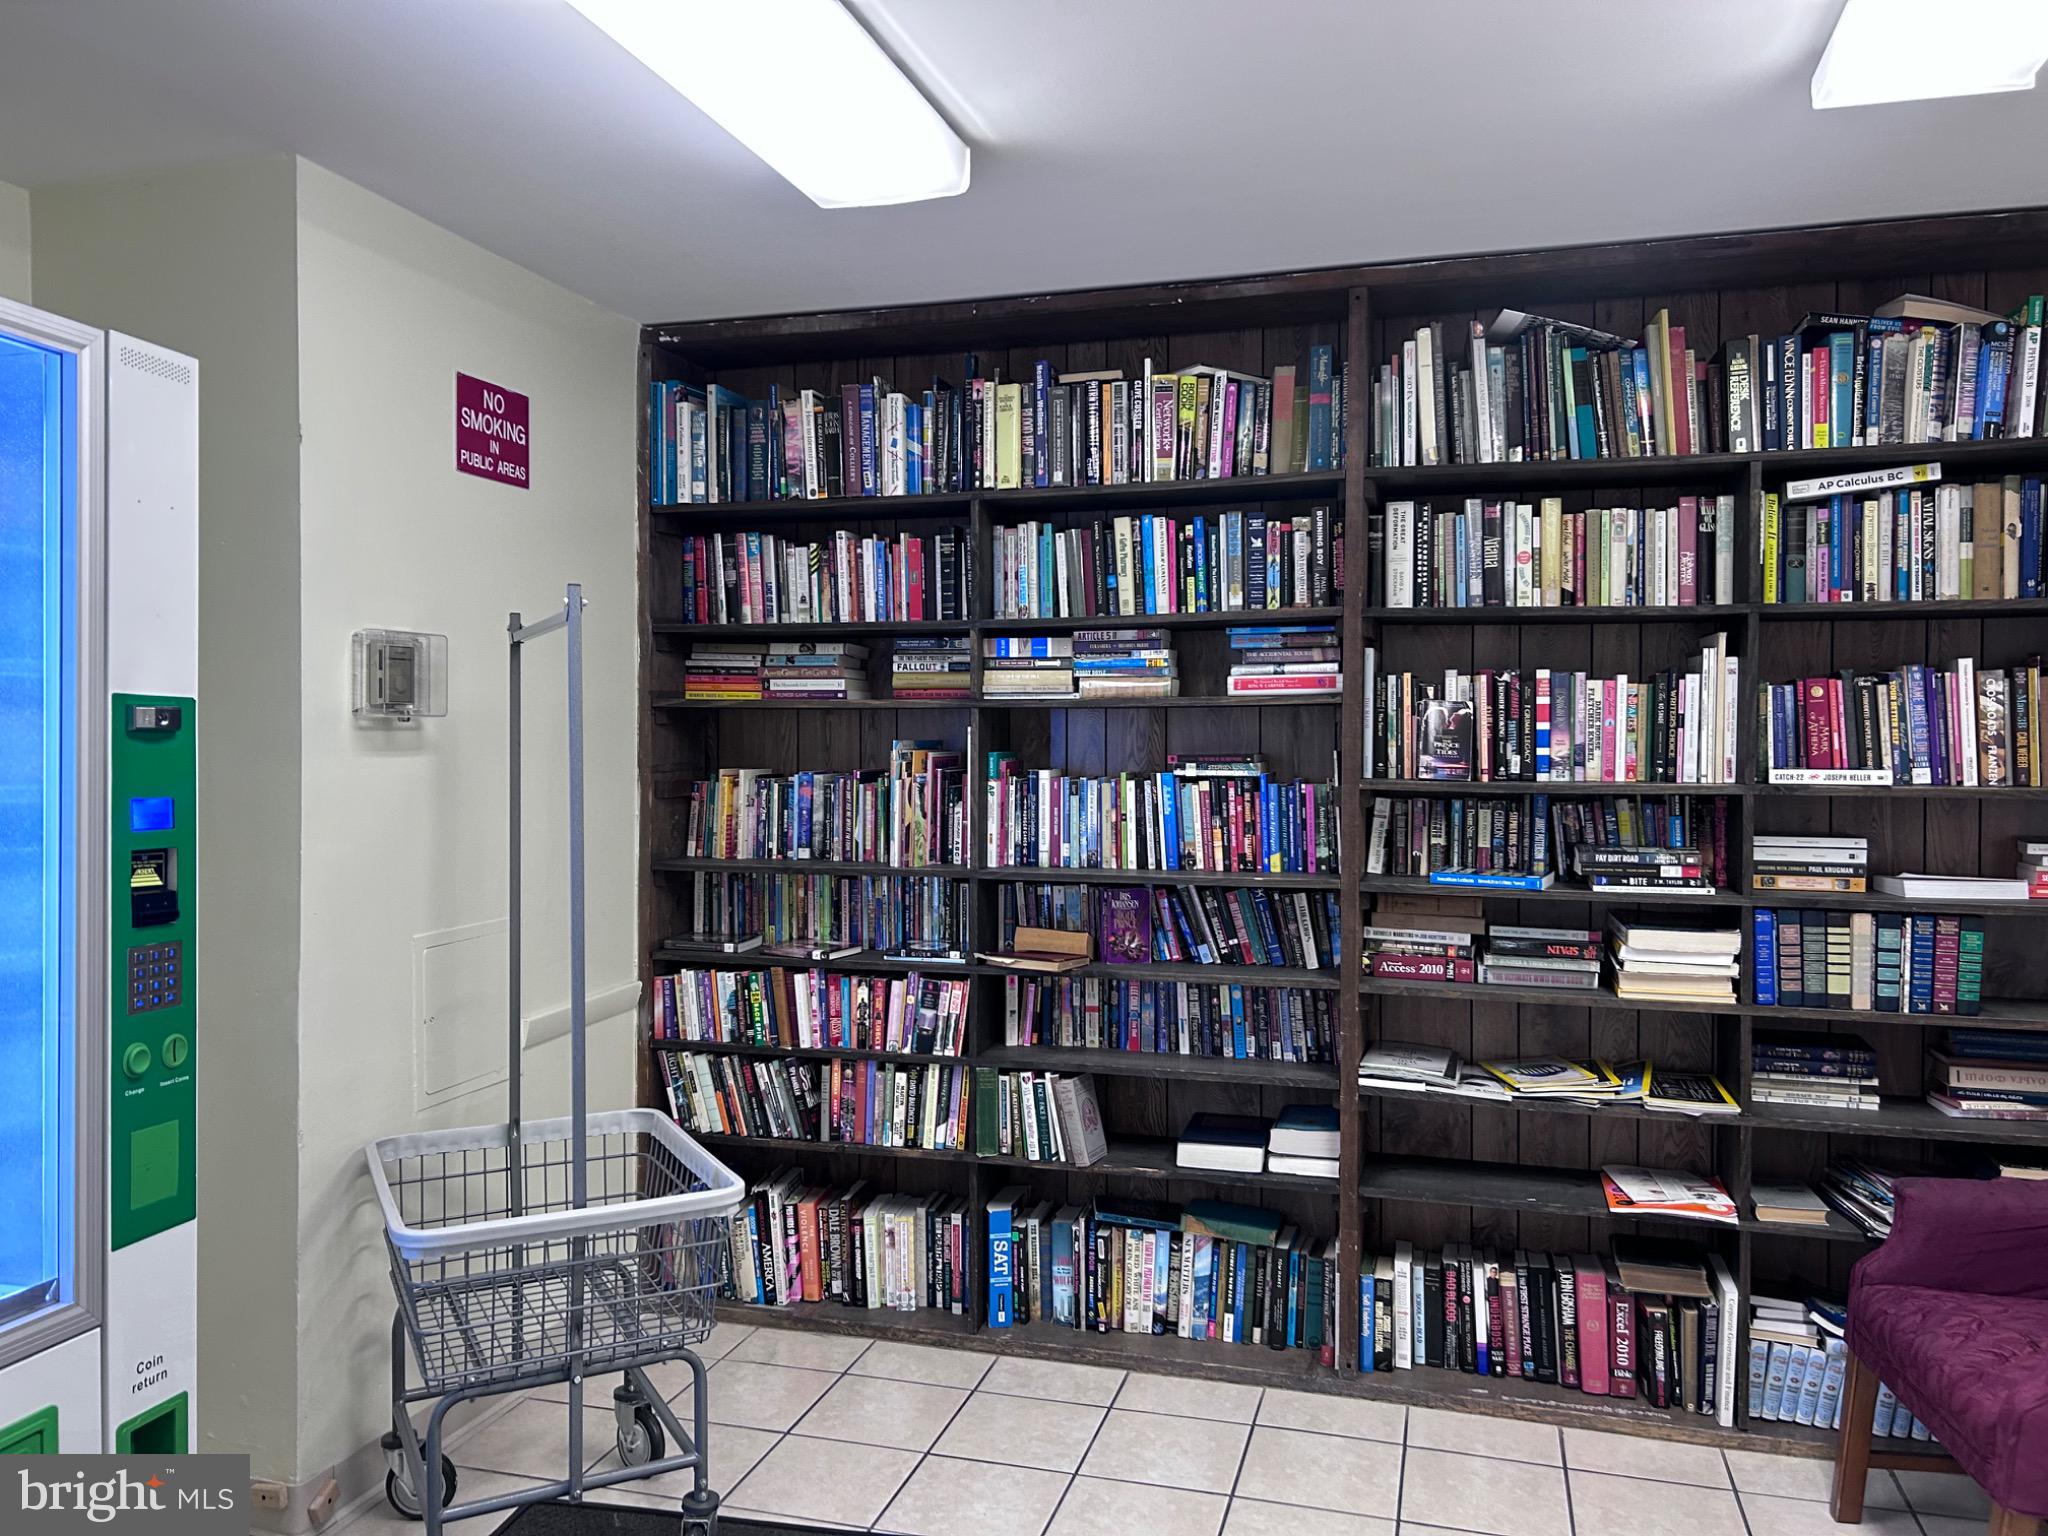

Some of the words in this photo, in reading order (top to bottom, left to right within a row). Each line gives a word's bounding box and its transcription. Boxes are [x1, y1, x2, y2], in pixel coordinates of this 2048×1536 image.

[2029, 331, 2038, 344] AP
[1785, 338, 1794, 369] VINCE
[1856, 356, 1864, 375] Brief
[2026, 347, 2037, 380] PHYSICS
[1036, 364, 1044, 389] Health
[1785, 369, 1794, 399] FLYNN
[1915, 358, 1923, 389] CLOISTERS
[483, 388, 505, 414] NO
[1133, 380, 1142, 399] CLIVE
[1180, 383, 1188, 411] COOK
[1187, 383, 1195, 411] ROBIN
[1740, 375, 1749, 401] DESK
[1133, 400, 1142, 430] CUSSLER
[1625, 378, 1633, 427] COMMUNICATION
[1729, 376, 1741, 433] REFERENCE
[460, 406, 526, 446] SMOKING
[1022, 408, 1033, 433] BLOOD
[1037, 400, 1045, 435] Wellness
[1162, 399, 1173, 451] Network+
[489, 439, 500, 455] IN
[862, 411, 873, 471] MANAGEMENT
[1022, 436, 1033, 455] HEAT
[460, 449, 494, 472] PUBLIC
[497, 459, 526, 481] AREAS
[1818, 481, 1834, 491] AP
[1836, 475, 1885, 488] Calculus
[1887, 471, 1904, 481] BC
[1767, 499, 1777, 528] Believe
[1923, 502, 1934, 529] VITAL
[1316, 510, 1324, 547] BURNING
[1186, 544, 1194, 569] KenKen
[1483, 535, 1501, 568] Ariana
[1923, 531, 1934, 559] SIGNS
[1313, 572, 1321, 597] AUSTER
[1077, 632, 1105, 640] ARTICLE
[1106, 632, 1112, 640] 5
[897, 663, 937, 671] FALLOUT
[1912, 680, 1925, 703] GAME
[2016, 694, 2026, 713] Man
[1668, 689, 1677, 728] WRITER'S
[1809, 711, 1816, 721] OF
[1913, 704, 1926, 726] MUST
[1985, 678, 1997, 736] CROSSROADS
[1498, 710, 1506, 737] COOKING
[1914, 728, 1926, 740] GO
[1523, 735, 1531, 764] LEGACY
[1668, 728, 1677, 759] CHOICE
[1808, 721, 1818, 756] ATHENA
[1820, 726, 1830, 754] MARK
[1914, 741, 1926, 753] ON
[2016, 731, 2027, 748] CARL
[1987, 745, 1998, 785] FRANZEN
[2017, 748, 2028, 768] WEBER
[988, 785, 995, 797] AP
[1493, 810, 1505, 838] GIDEON
[1508, 811, 1518, 833] STEPHEN
[1534, 817, 1544, 833] JAMES
[1508, 833, 1518, 846] KING
[1534, 833, 1544, 859] PATTERSON
[1595, 854, 1609, 862] PAY
[1609, 855, 1623, 863] DIRT
[1623, 855, 1639, 863] ROAD
[1824, 866, 1854, 874] KRUGMAN
[1628, 877, 1648, 886] BITE
[1544, 944, 1579, 956] SPAIN
[1379, 961, 1416, 974] Access
[1419, 963, 1444, 975] 2010
[667, 1053, 682, 1078] LIGHT
[908, 1079, 918, 1096] DAVID
[907, 1096, 917, 1124] BALDACCI
[800, 1209, 809, 1253] VIOLENCE
[829, 1208, 839, 1228] DALE
[830, 1228, 841, 1268] BROWN
[993, 1240, 1008, 1276] SAT
[1170, 1250, 1180, 1269] THE
[762, 1242, 775, 1291] AMERICA
[854, 1249, 862, 1280] OWNERSHIP
[1182, 1255, 1191, 1295] MATTERS
[936, 1268, 944, 1292] TRAPS
[1132, 1272, 1140, 1295] WHITE
[1445, 1271, 1456, 1290] BAD
[1559, 1273, 1573, 1292] JOHN
[1362, 1293, 1370, 1306] Soft
[1446, 1290, 1456, 1322] BLOOD
[1519, 1285, 1528, 1305] FIRST
[1489, 1295, 1502, 1347] UNDERBOSS
[1521, 1305, 1530, 1336] STRANGE
[1561, 1292, 1575, 1325] GRISHAM
[1615, 1302, 1629, 1335] Excel
[1726, 1297, 1736, 1332] Corporate
[1361, 1307, 1369, 1337] Underbelly
[1565, 1328, 1574, 1340] THE
[1523, 1336, 1531, 1357] PLACE
[1566, 1341, 1575, 1370] CHAMBER
[1616, 1337, 1629, 1365] 2010
[1654, 1329, 1664, 1371] FREEDOMLAND
[1725, 1332, 1734, 1372] Governance
[136, 1354, 164, 1375] Coin
[131, 1369, 168, 1394] return
[1725, 1373, 1733, 1384] and
[1723, 1386, 1732, 1412] Finance
